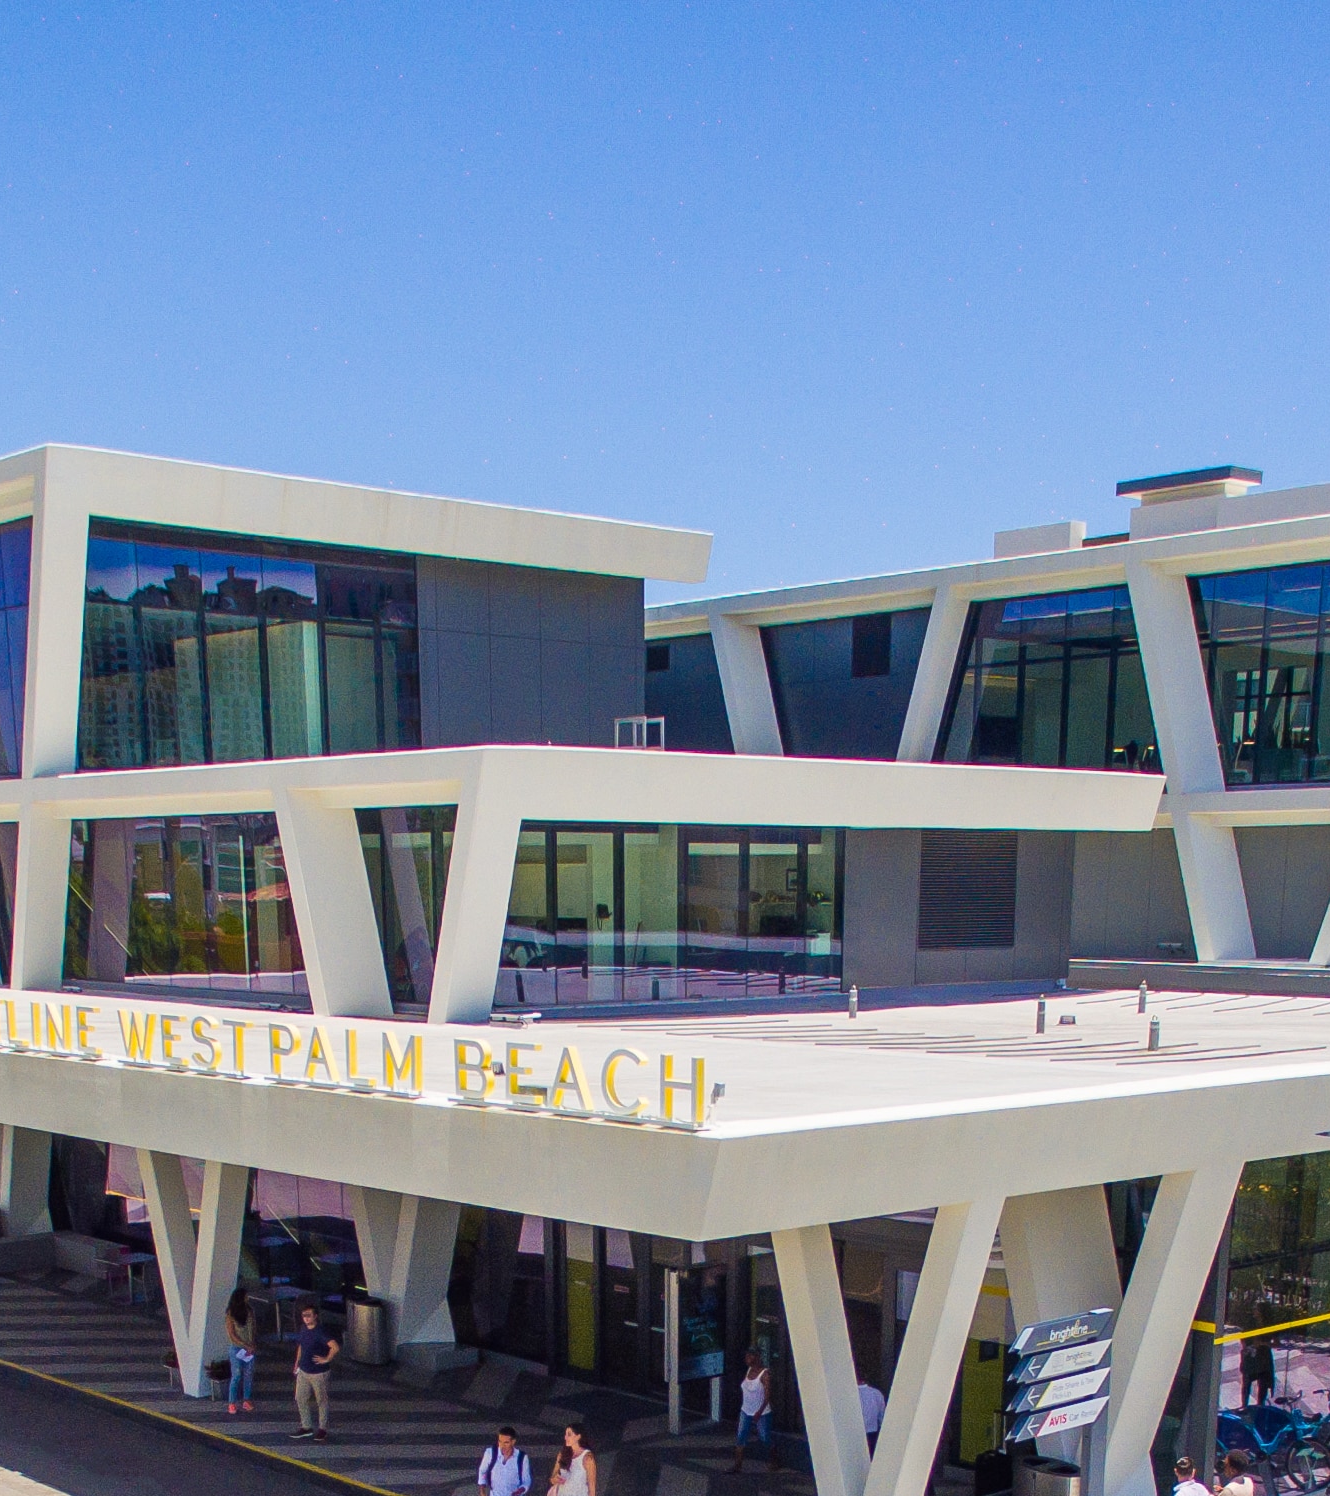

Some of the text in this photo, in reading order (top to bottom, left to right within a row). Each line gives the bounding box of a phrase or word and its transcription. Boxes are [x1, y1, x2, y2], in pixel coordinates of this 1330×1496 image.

[117, 1009, 254, 1077] WEST
[269, 1022, 424, 1095] PALM
[453, 1038, 706, 1128] BEACH
[1049, 1319, 1089, 1343] brightline
[1049, 1413, 1067, 1427] AVIS
[1069, 1413, 1080, 1422] Car
